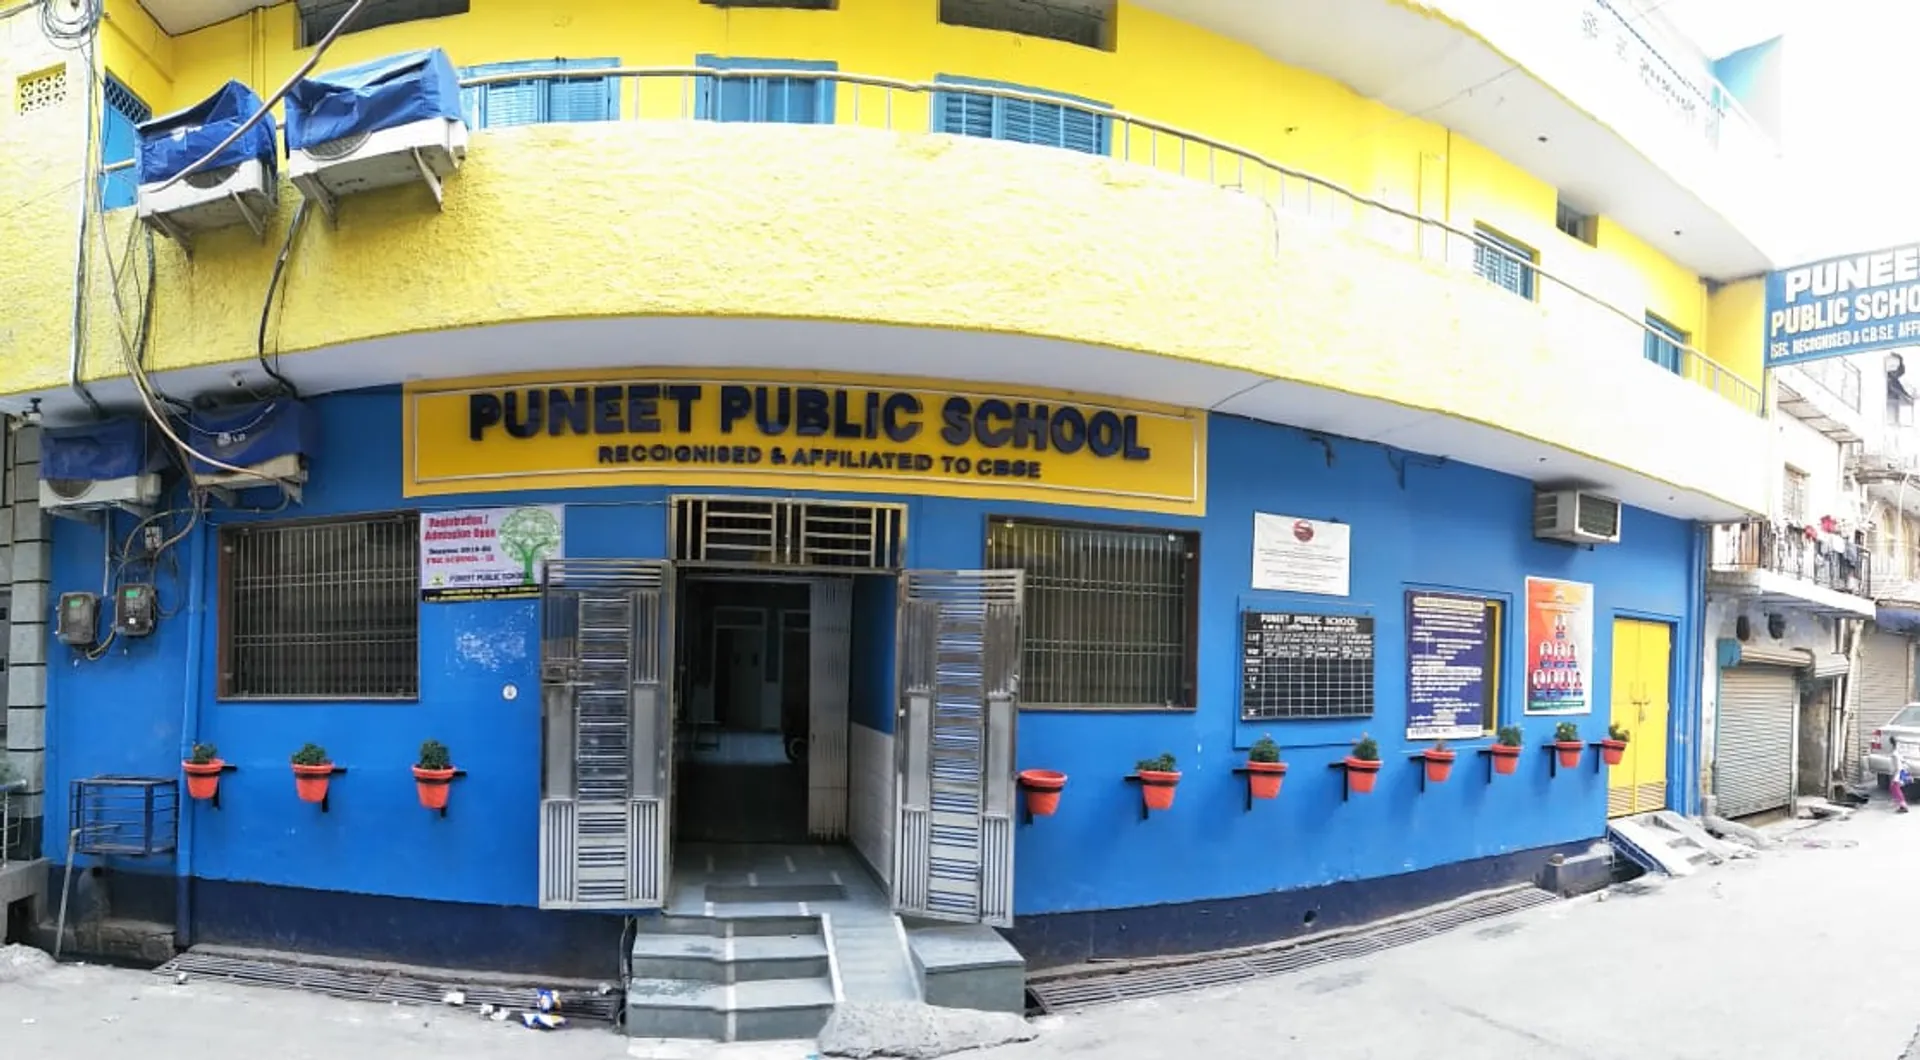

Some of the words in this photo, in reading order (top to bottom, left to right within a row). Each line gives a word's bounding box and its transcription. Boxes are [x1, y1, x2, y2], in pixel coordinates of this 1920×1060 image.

[1771, 297, 1850, 338] PUBLIC
[469, 384, 702, 441] PUNEET
[720, 385, 923, 443] PUBLIC
[941, 396, 1150, 460] SCHOOL
[597, 443, 762, 464] RECOGNISED
[770, 447, 786, 465] &
[791, 448, 932, 472] AFFILIATED
[941, 455, 971, 475] TO
[976, 458, 1041, 479] CBSE
